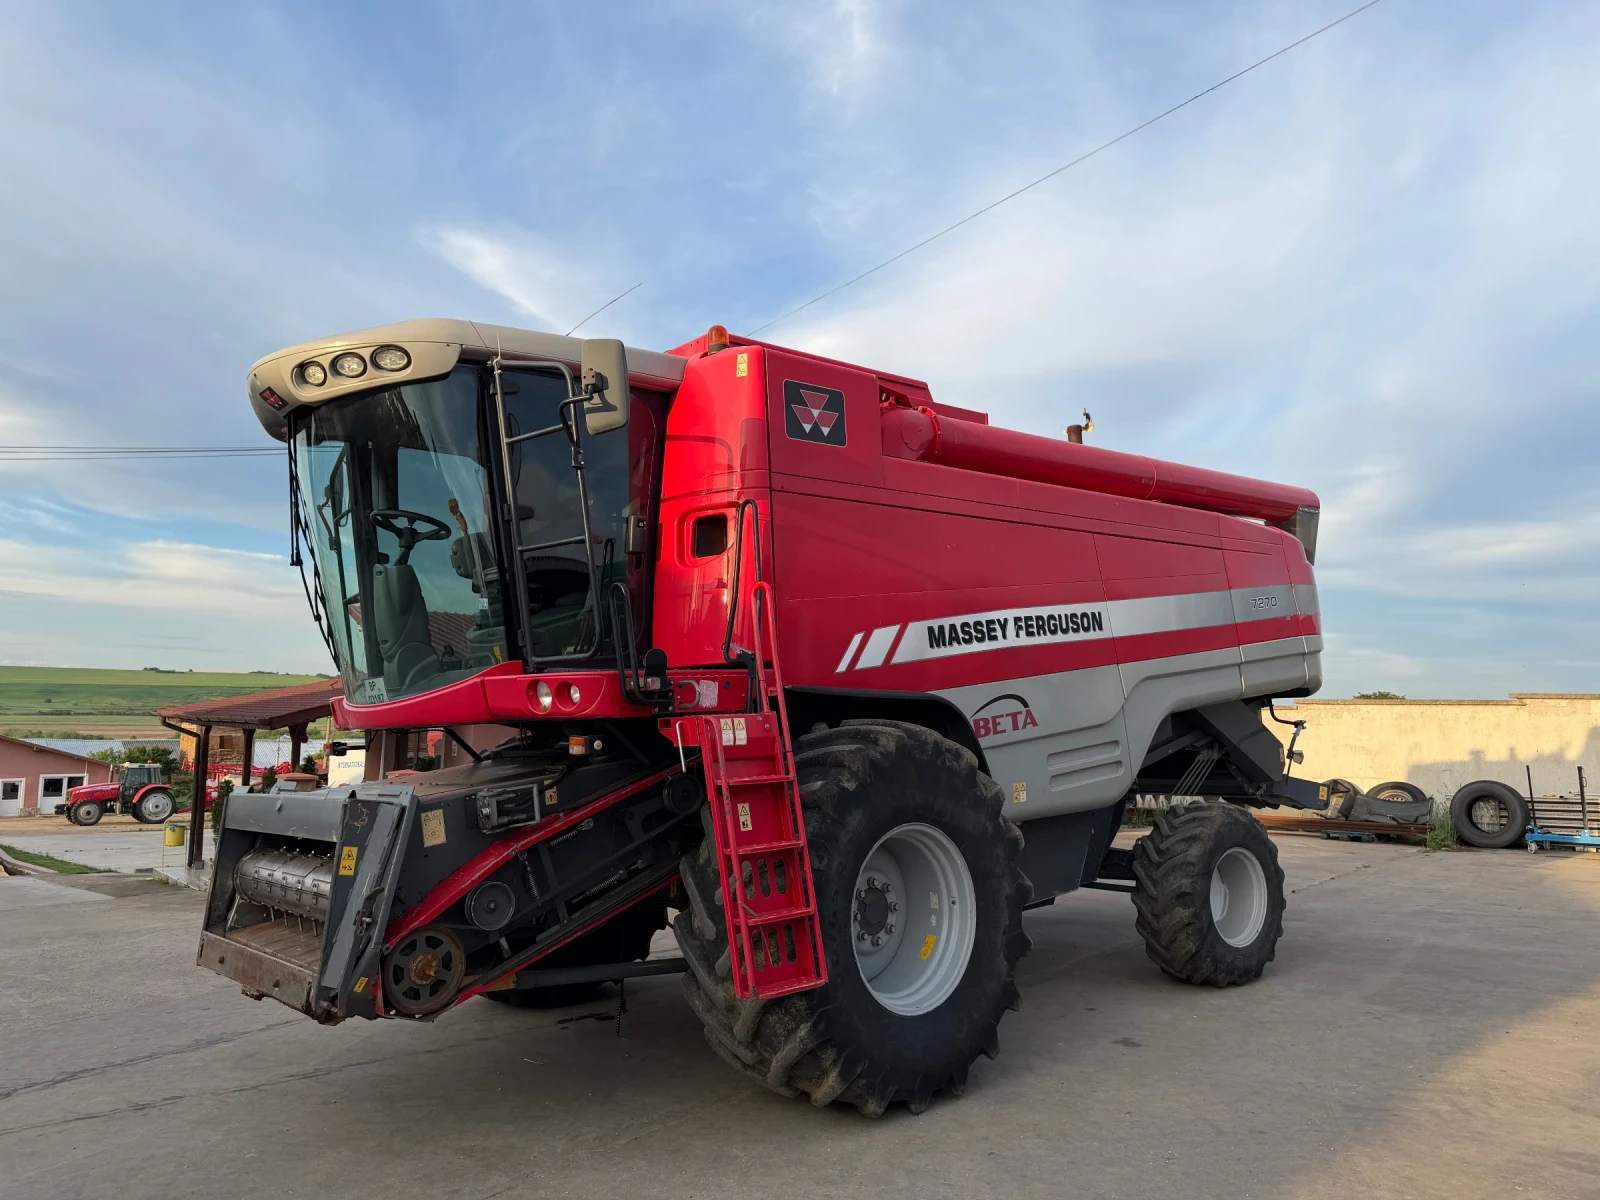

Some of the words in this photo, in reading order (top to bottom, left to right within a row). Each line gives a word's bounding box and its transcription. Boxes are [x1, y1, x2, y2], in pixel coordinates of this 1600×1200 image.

[1250, 596, 1277, 610] 7270
[927, 617, 1009, 649] MASSEY
[1013, 611, 1104, 639] FERGUSON
[972, 708, 1039, 739] BETA
